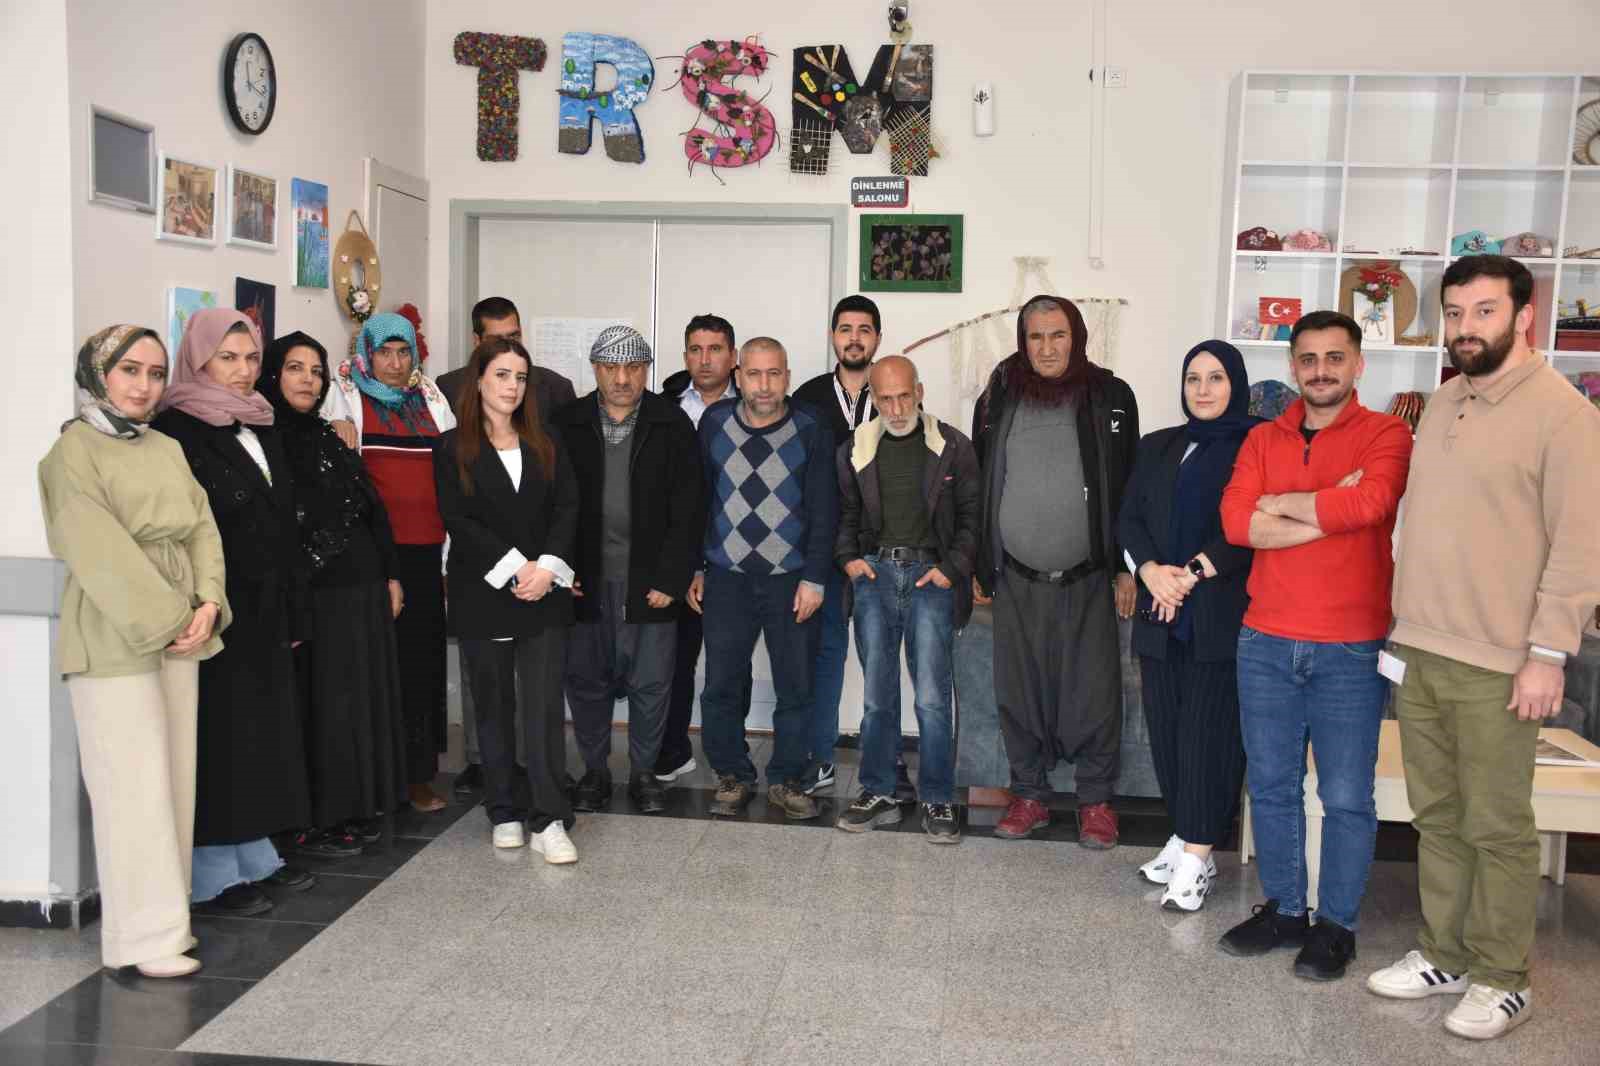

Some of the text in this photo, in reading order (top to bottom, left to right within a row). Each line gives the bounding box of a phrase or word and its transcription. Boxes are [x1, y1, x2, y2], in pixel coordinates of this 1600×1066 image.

[454, 31, 933, 176] TRSM
[852, 180, 905, 190] DİNLENME
[857, 193, 900, 202] SALONU
